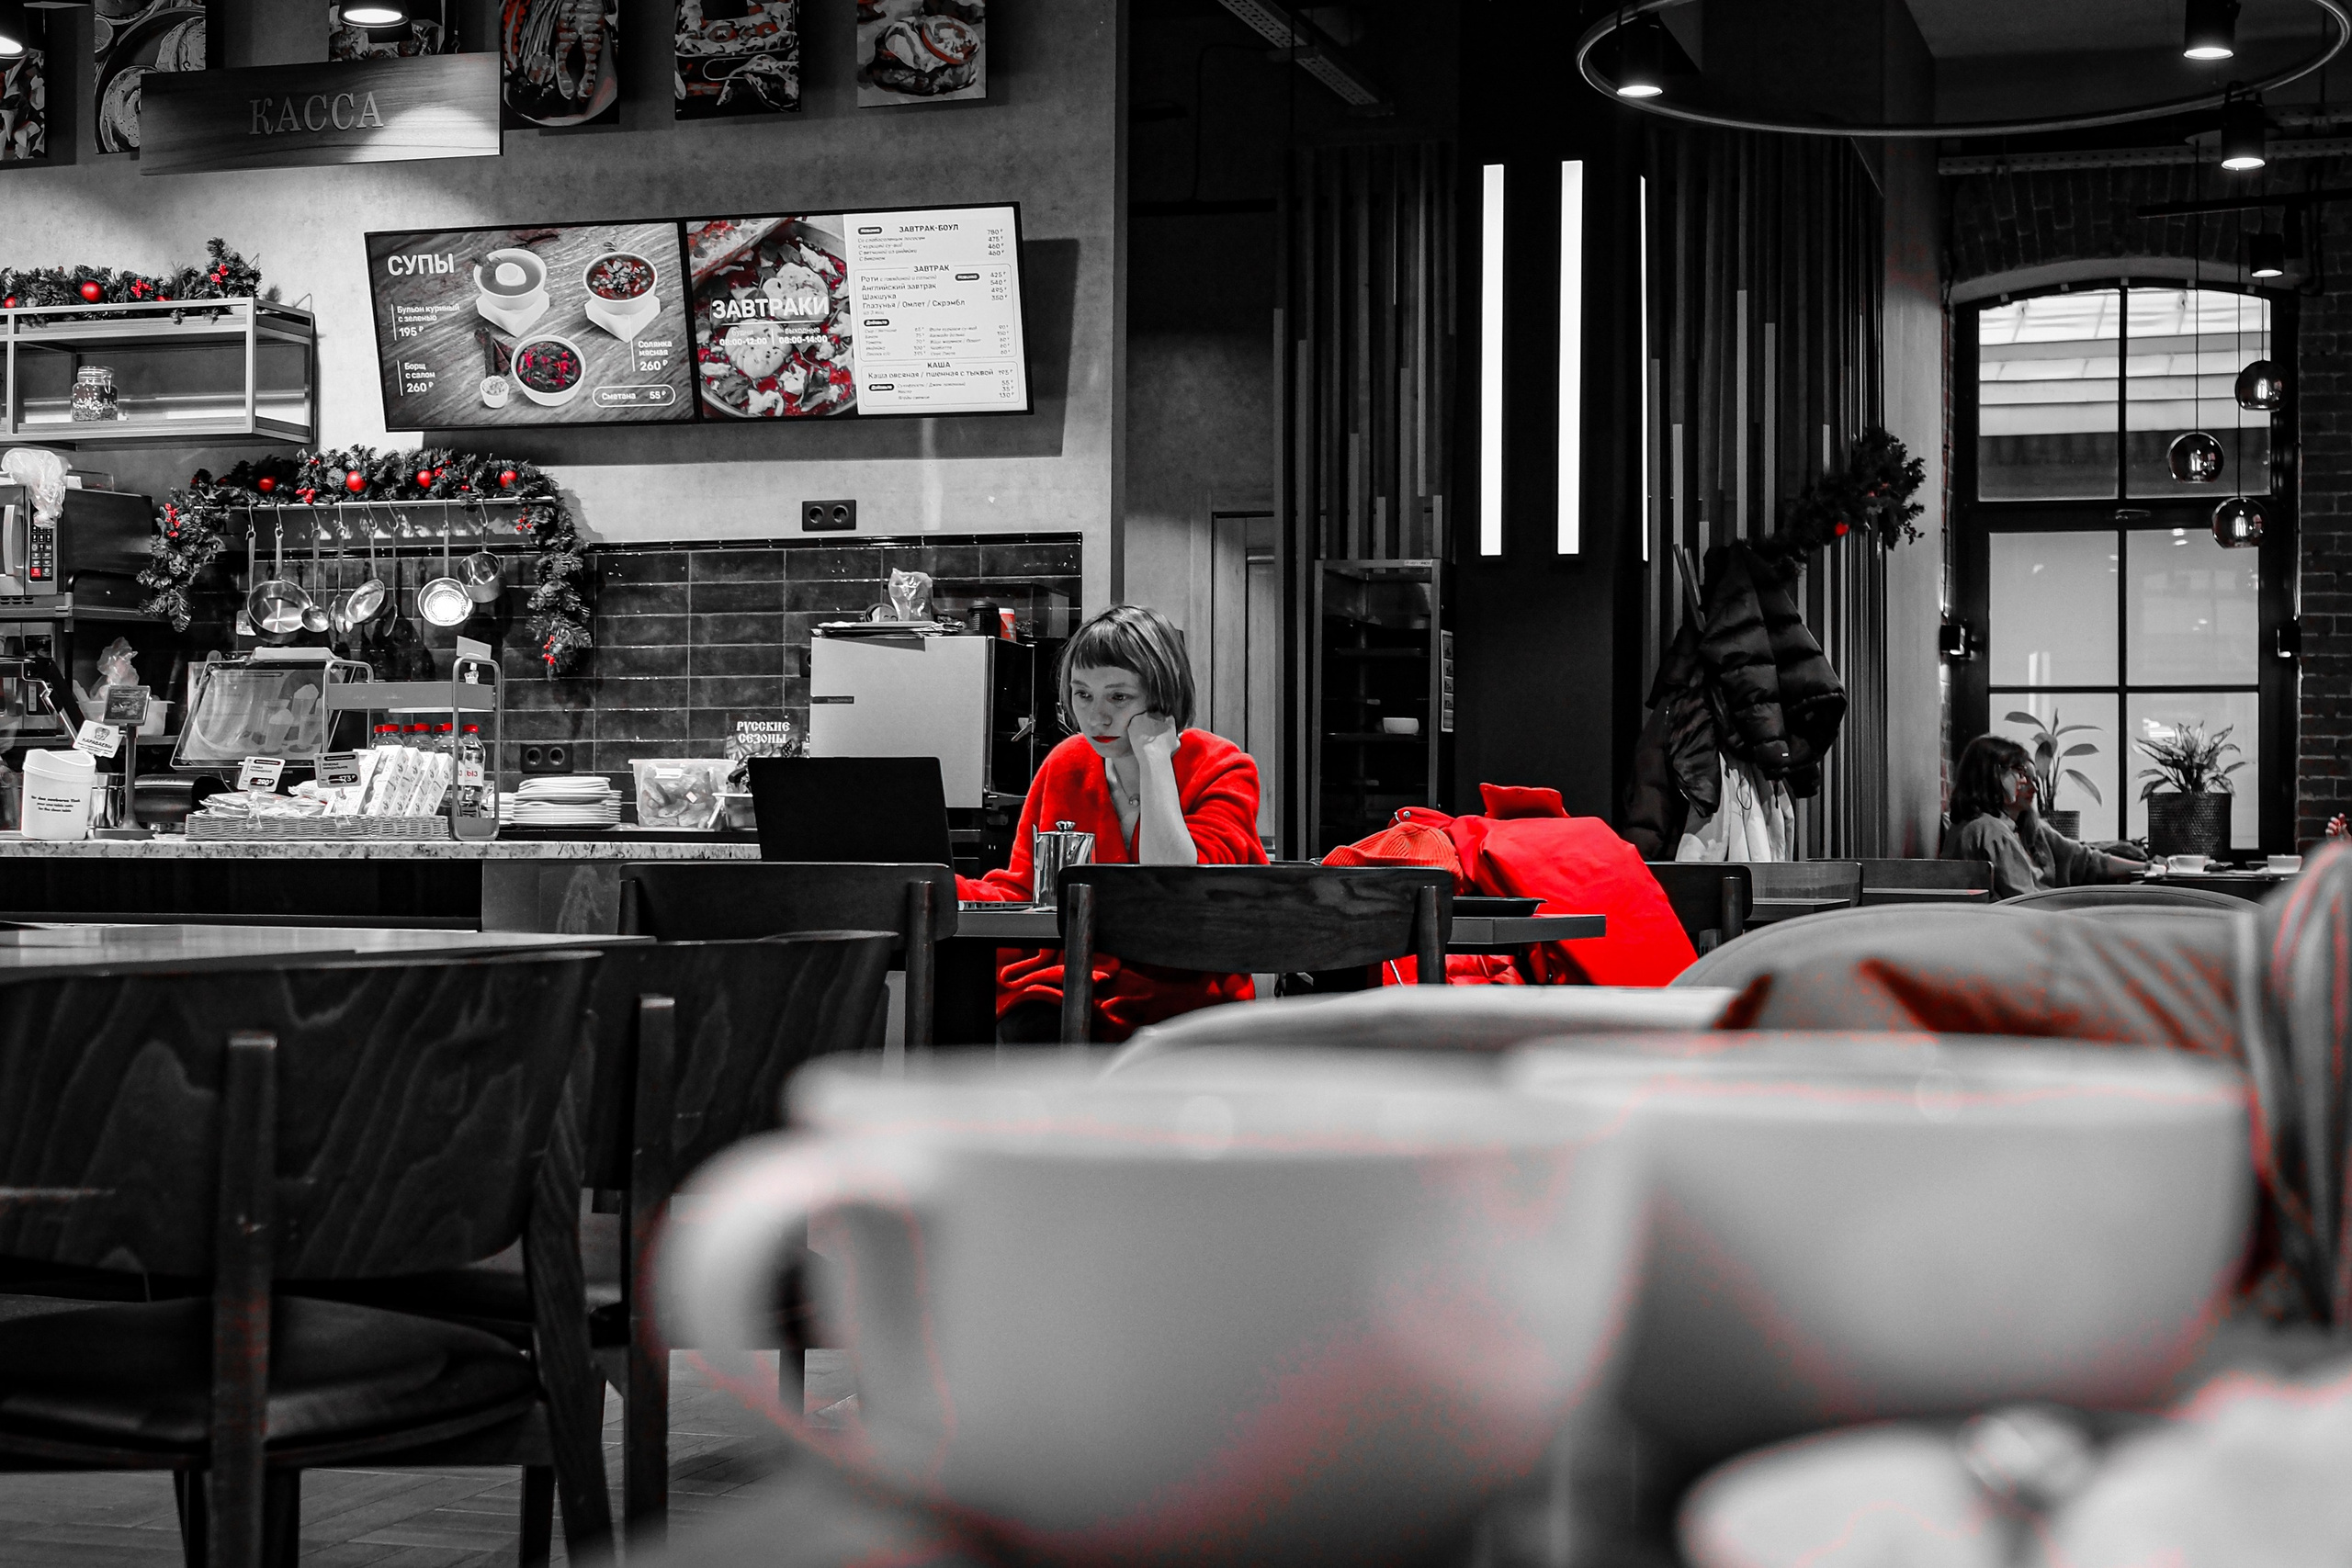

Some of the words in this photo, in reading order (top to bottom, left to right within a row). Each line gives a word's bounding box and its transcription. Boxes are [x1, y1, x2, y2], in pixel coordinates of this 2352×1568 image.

[249, 91, 384, 135] КАССА
[899, 224, 959, 233] ЗАВТРАК-БОУЛ
[387, 254, 455, 276] СУПЫ
[861, 282, 906, 292] Английский
[907, 283, 937, 291] завтрак
[862, 293, 897, 301] Шакшука
[397, 305, 425, 314] Бульон
[425, 303, 460, 313] куриный
[712, 296, 830, 319] ЗАВТРАКИ
[932, 299, 966, 309] Скрэмбл
[718, 337, 768, 346] 08:00-12:00
[778, 335, 828, 344] 08:00-14:00
[404, 362, 426, 371] Борщ
[601, 392, 637, 400] Сметана
[736, 721, 791, 734] РУССКИЕ
[738, 733, 787, 744] СЕЗОНЫ
